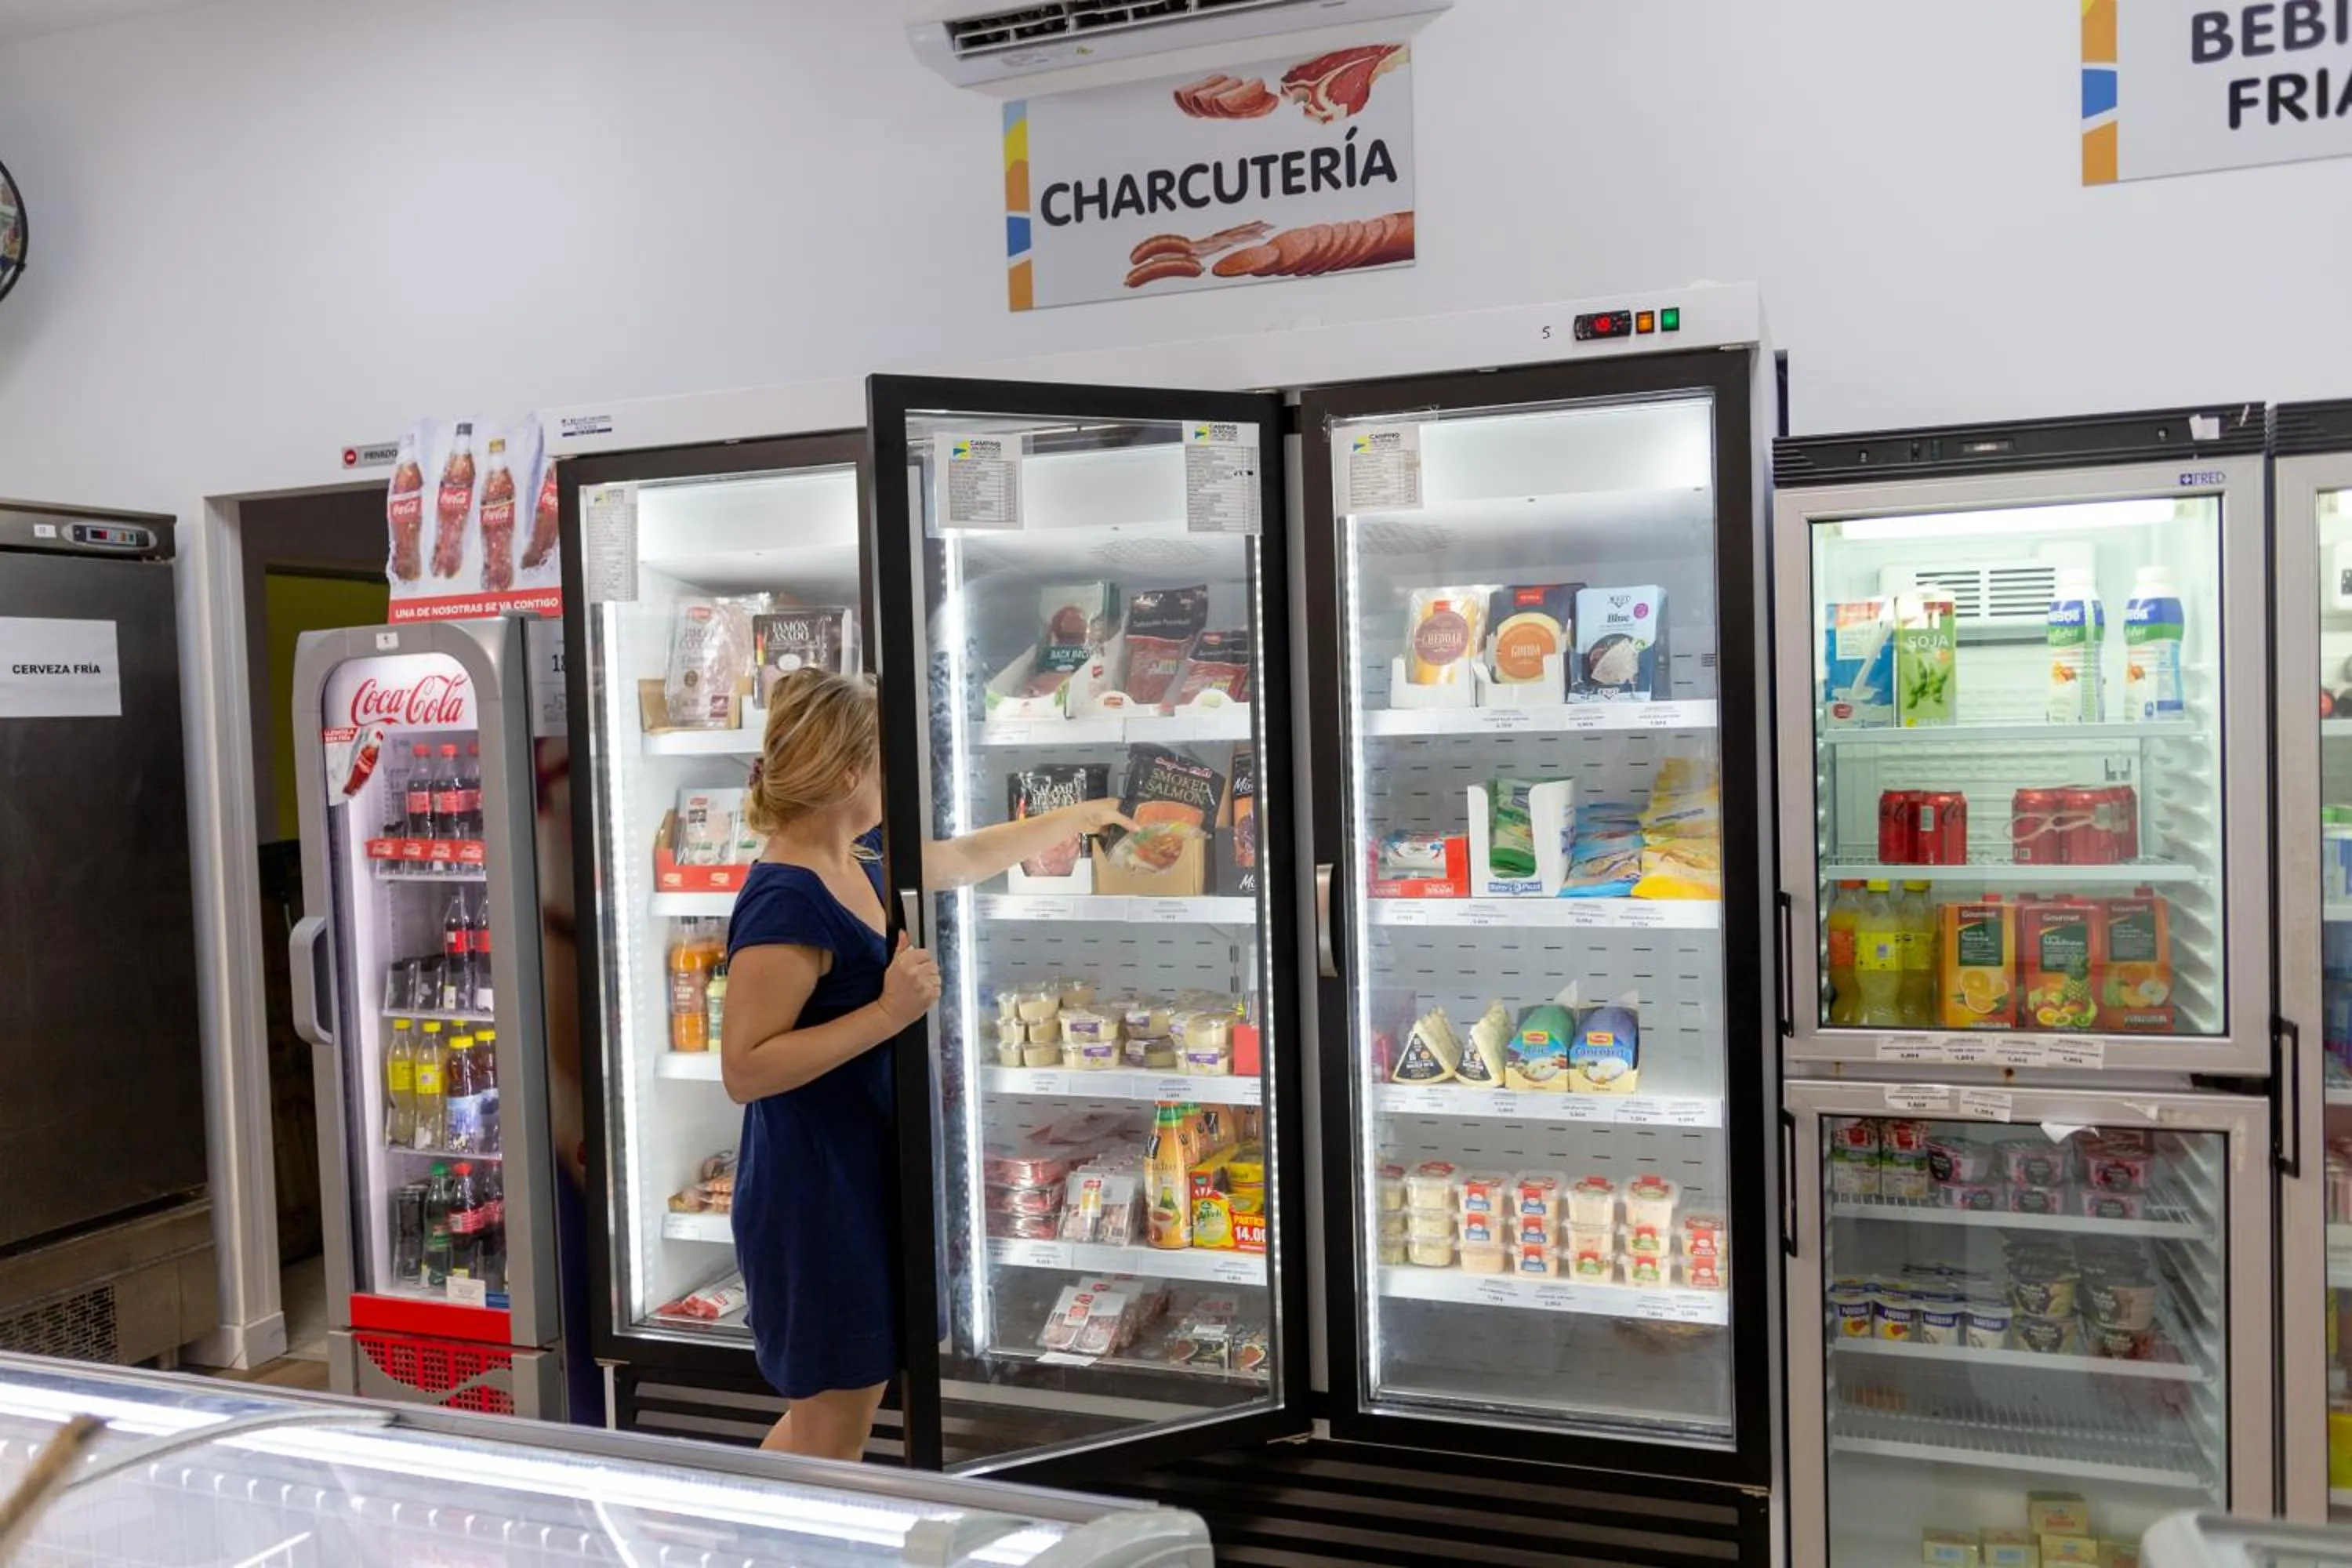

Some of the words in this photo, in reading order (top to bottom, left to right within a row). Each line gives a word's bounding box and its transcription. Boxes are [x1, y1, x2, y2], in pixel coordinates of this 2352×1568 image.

[2191, 0, 2348, 64] BEBI
[1040, 126, 1398, 227] CHARCUTERÍA
[364, 449, 397, 460] PRIVADO
[395, 608, 415, 618] UNA
[417, 607, 430, 616] DE
[432, 604, 483, 615] NOSOTRAS
[485, 602, 498, 612] SE
[499, 601, 512, 610] VA
[514, 597, 559, 608] CONTIGO
[1421, 632, 1462, 644] CHEDDAR
[1907, 635, 1949, 648] SOJA
[12, 665, 71, 674] CERVEZA
[74, 663, 101, 674] FRÍA
[350, 673, 467, 727] Coca-Cola
[1152, 768, 1210, 792] SMOKED
[1145, 780, 1207, 806] SALMON
